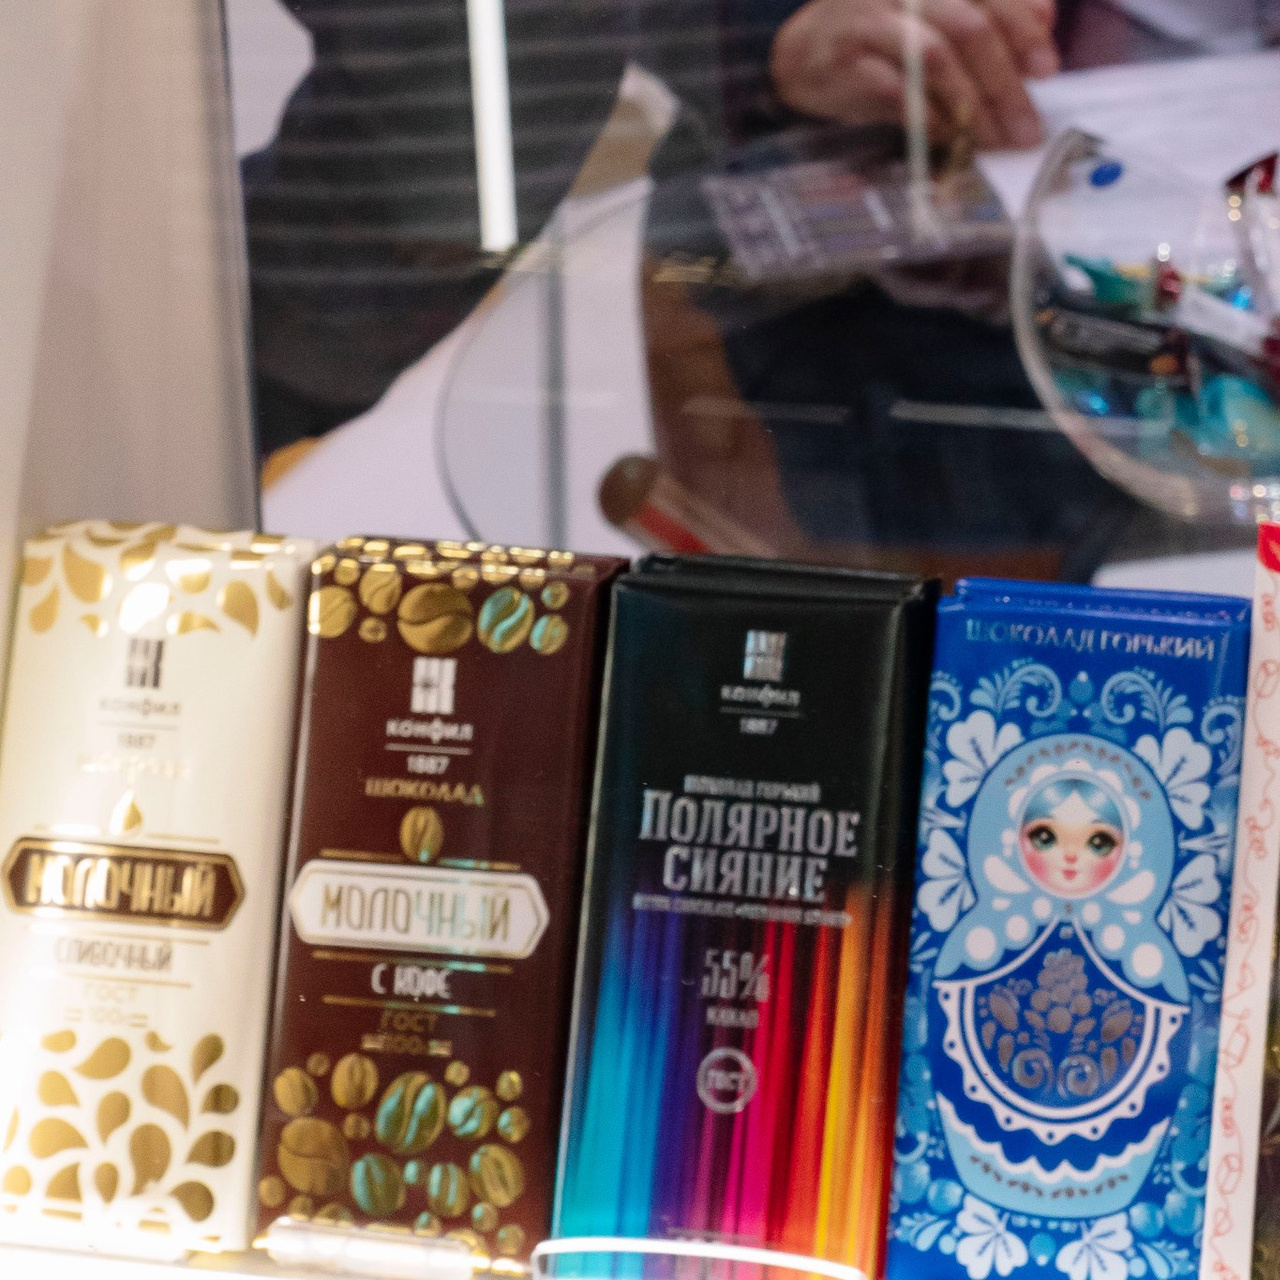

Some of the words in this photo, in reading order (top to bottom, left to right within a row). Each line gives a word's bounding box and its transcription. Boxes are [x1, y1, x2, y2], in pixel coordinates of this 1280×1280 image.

[1100, 629, 1216, 662] ГОРЬКИЙ
[364, 776, 485, 807] ШОКОЛАД
[638, 788, 861, 858] ПОЛЯРНОЕ
[662, 844, 829, 904] СИЯНИЕ
[320, 883, 511, 942] МОЛОЧНЫЙ
[701, 949, 771, 1003] 55%
